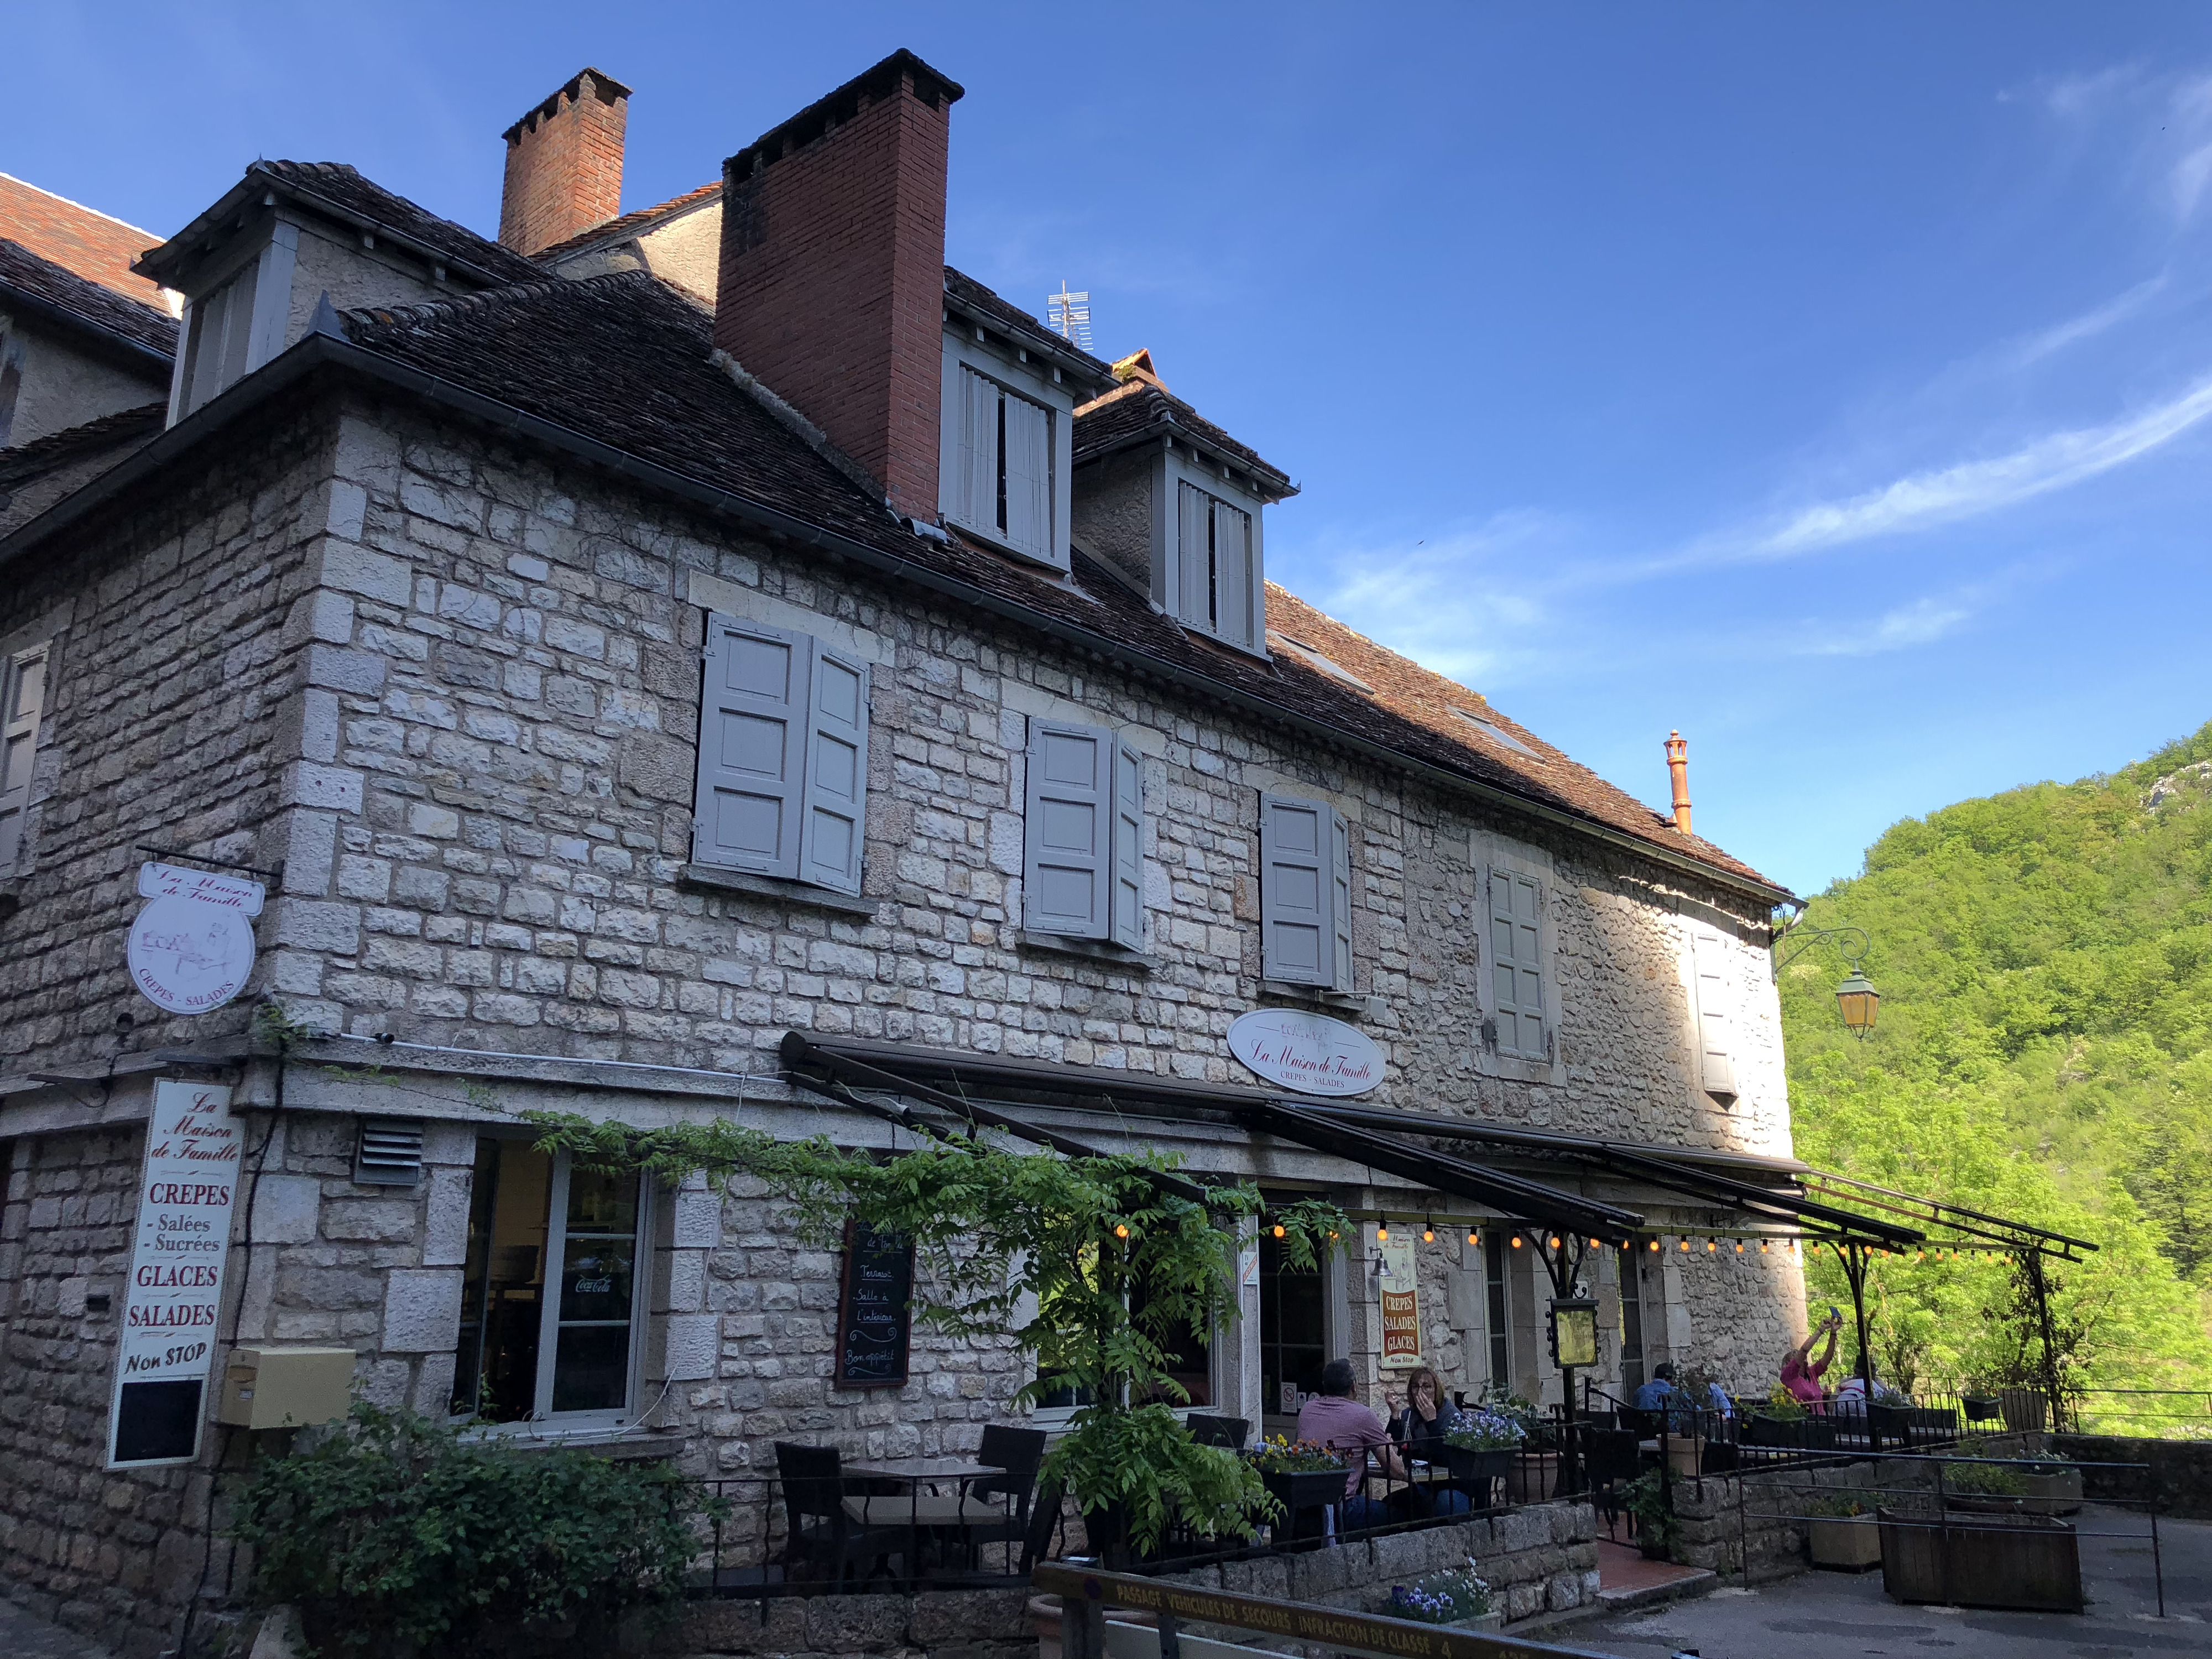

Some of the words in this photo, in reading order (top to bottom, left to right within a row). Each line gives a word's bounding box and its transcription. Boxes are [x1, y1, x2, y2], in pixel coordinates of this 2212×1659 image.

[157, 870, 183, 883] La
[186, 878, 253, 898] Maison
[162, 886, 179, 895] de
[182, 888, 244, 907] Famille
[139, 968, 175, 1001] CREPES
[186, 980, 234, 1005] SALADES
[1248, 1039, 1270, 1063] La
[1272, 1045, 1317, 1071] Maison
[1318, 1056, 1331, 1074] de
[1332, 1055, 1371, 1080] Famille
[1280, 1071, 1307, 1082] CREPES
[1314, 1077, 1345, 1088] SALADES
[186, 1092, 218, 1113] La
[163, 1115, 232, 1138] Maison
[151, 1141, 170, 1158] de
[173, 1139, 239, 1161] Famille
[149, 1182, 229, 1206] CREPES
[158, 1213, 211, 1232] Salées
[155, 1233, 220, 1251] Sucrées
[137, 1265, 218, 1287] GLACES
[855, 1288, 878, 1301] Salle
[1386, 1295, 1412, 1311] CREPES
[128, 1304, 215, 1327] SALADES
[1385, 1316, 1416, 1331] SALADES
[1387, 1335, 1415, 1351] GLACES
[124, 1354, 161, 1375] Non
[165, 1342, 207, 1366] STOP
[844, 1349, 864, 1365] Bon
[866, 1349, 894, 1366] appétit
[1117, 1584, 1162, 1607] PASSAGE
[1166, 1593, 1221, 1618] VEHICULES
[1222, 1603, 1237, 1620] DE
[1243, 1606, 1291, 1630] SECOURS
[1299, 1615, 1368, 1643] INFRACTION
[1371, 1629, 1386, 1647] DE
[1388, 1631, 1431, 1655] CLASSE
